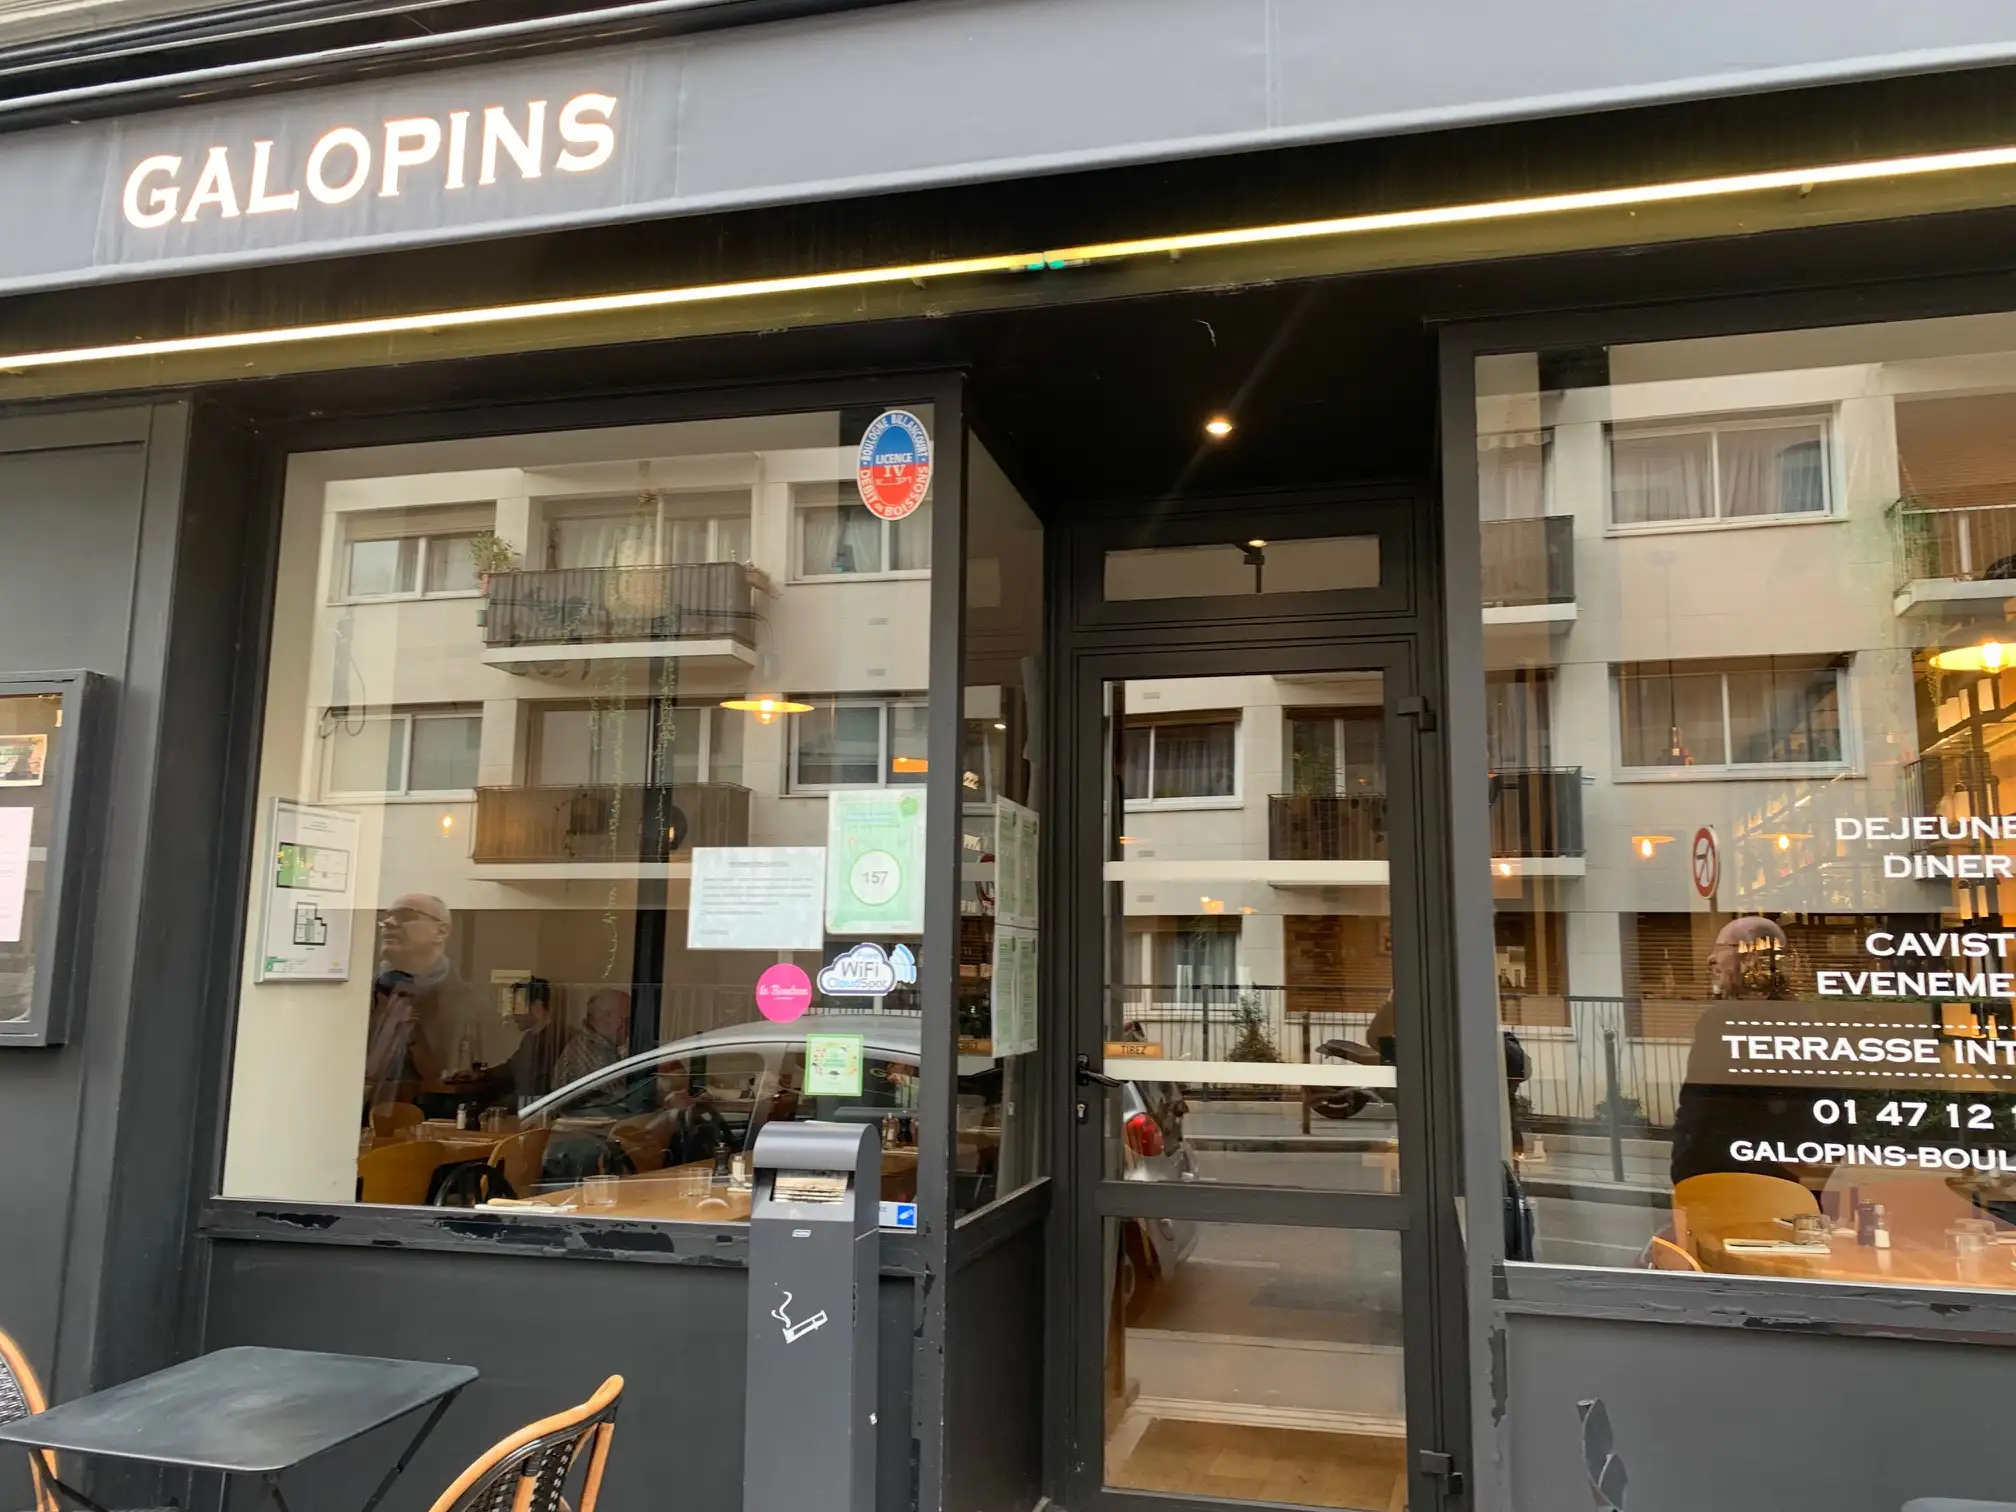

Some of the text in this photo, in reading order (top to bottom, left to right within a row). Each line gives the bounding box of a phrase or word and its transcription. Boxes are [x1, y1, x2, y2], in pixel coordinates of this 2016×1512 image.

[122, 92, 617, 229] GALOPINS
[861, 414, 928, 462] BOULOGNE BILLANCOURT
[875, 453, 913, 464] LICENCE
[884, 465, 906, 477] IV
[884, 465, 929, 515] BOISSONS
[862, 870, 889, 885] 157
[1883, 854, 2014, 879] DINER
[1866, 932, 2016, 957] CAVIST
[841, 961, 880, 978] WiFi
[1816, 971, 2016, 997] EVENEME
[1120, 1045, 1147, 1055] TIREZ
[1722, 1035, 2016, 1065] TERRASSE INT
[1813, 1099, 1857, 1125] 01
[1876, 1101, 1928, 1127] 47
[1946, 1103, 1994, 1130] 12
[1729, 1140, 2016, 1171] GALOPINS-BOUL
